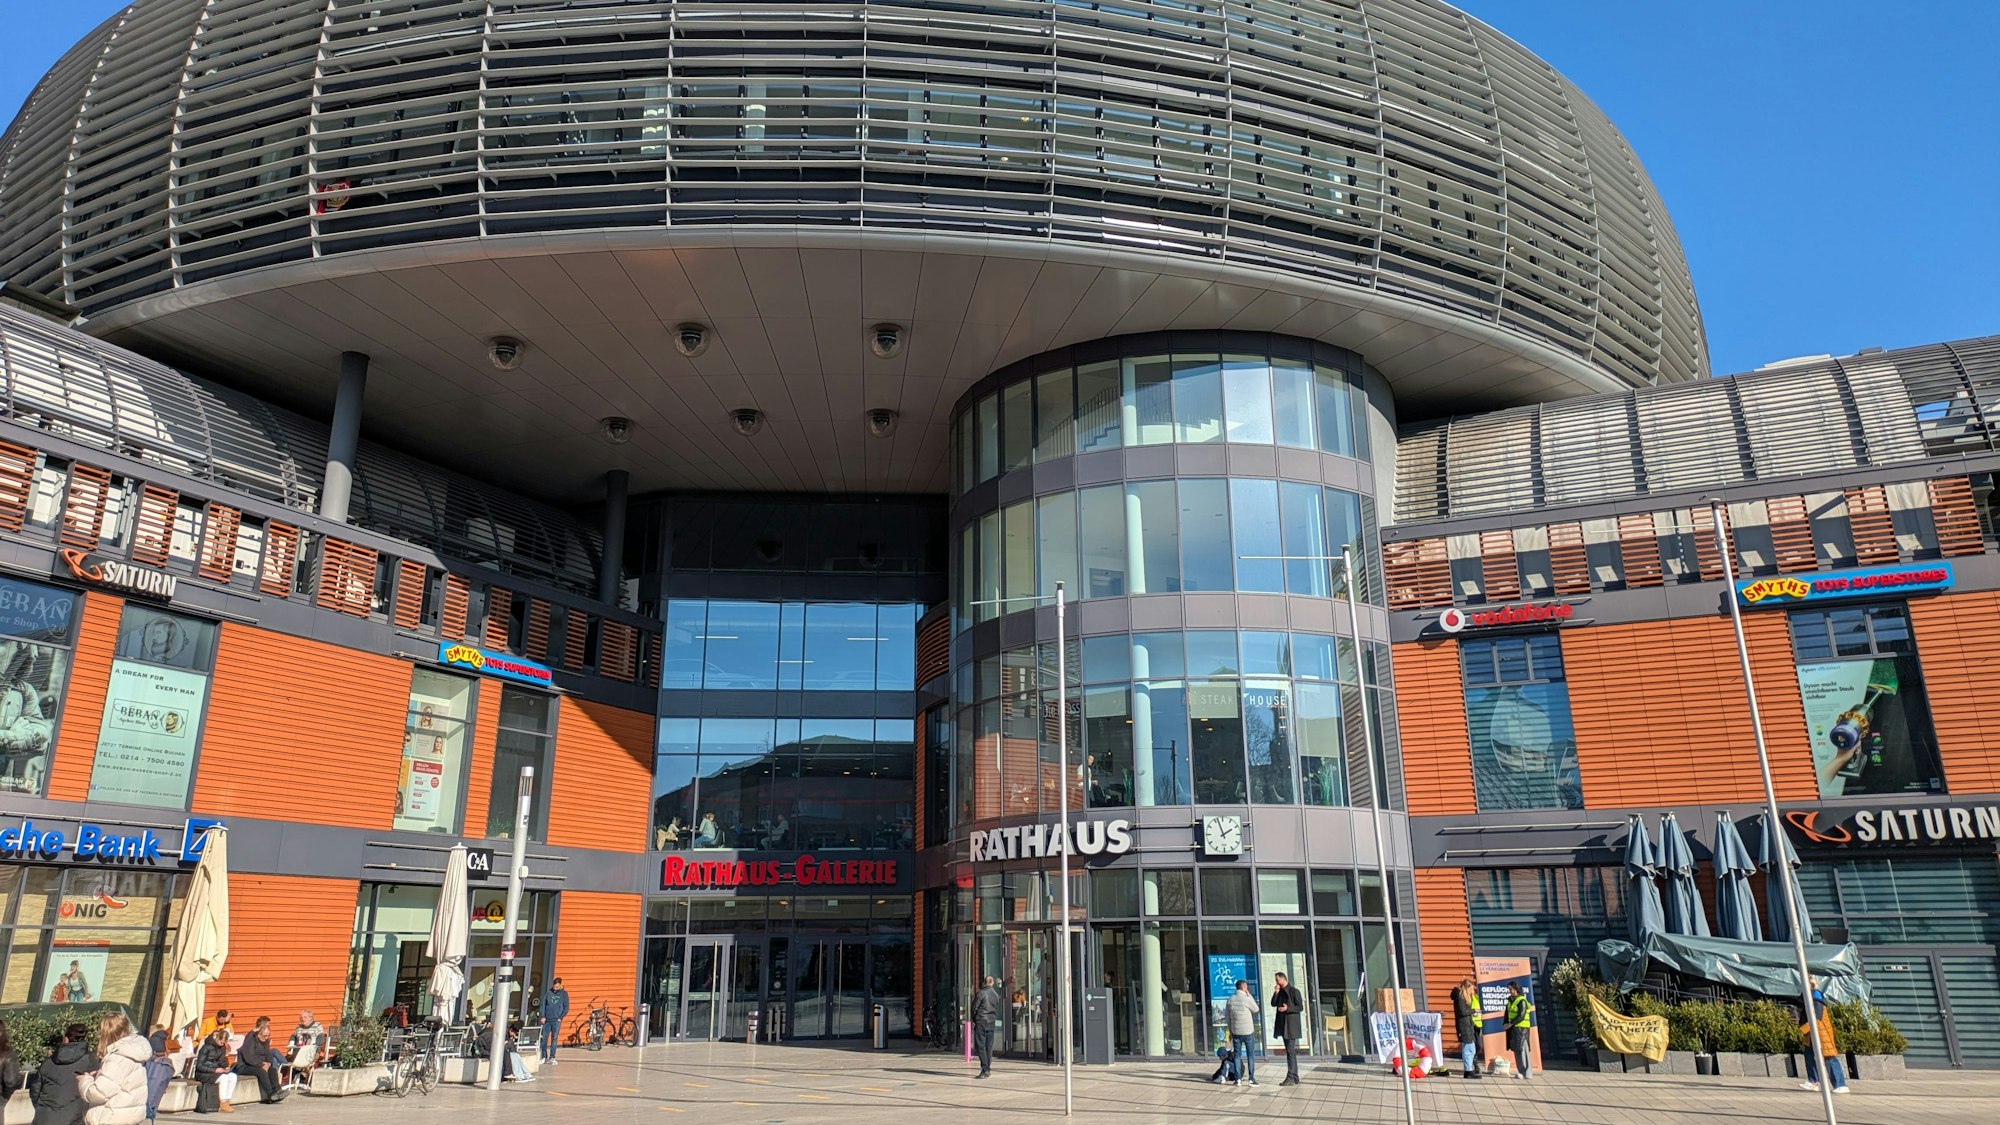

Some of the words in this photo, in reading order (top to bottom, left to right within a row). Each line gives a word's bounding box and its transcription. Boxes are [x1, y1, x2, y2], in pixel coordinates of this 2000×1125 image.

[103, 560, 177, 597] SATURN
[1743, 579, 1809, 600] SMYTHS
[1814, 578, 1849, 591] TOYS
[1853, 569, 1948, 589] SUPERSTORES
[13, 616, 40, 630] Shop
[1471, 602, 1573, 626] vodafone
[447, 647, 484, 667] SMYTHS
[122, 669, 148, 678] DREAM
[155, 684, 178, 692] EVERY
[180, 688, 195, 696] MAN
[1200, 694, 1233, 705] STEAK
[1249, 695, 1286, 706] HOUSE
[120, 706, 158, 721] BEBAN
[147, 757, 165, 765] 7500
[1855, 806, 2000, 842] SATURN
[74, 825, 161, 860] Bank
[969, 819, 1133, 863] RATHAUS
[467, 852, 489, 871] C&A
[1627, 1026, 1660, 1034] HETZE
